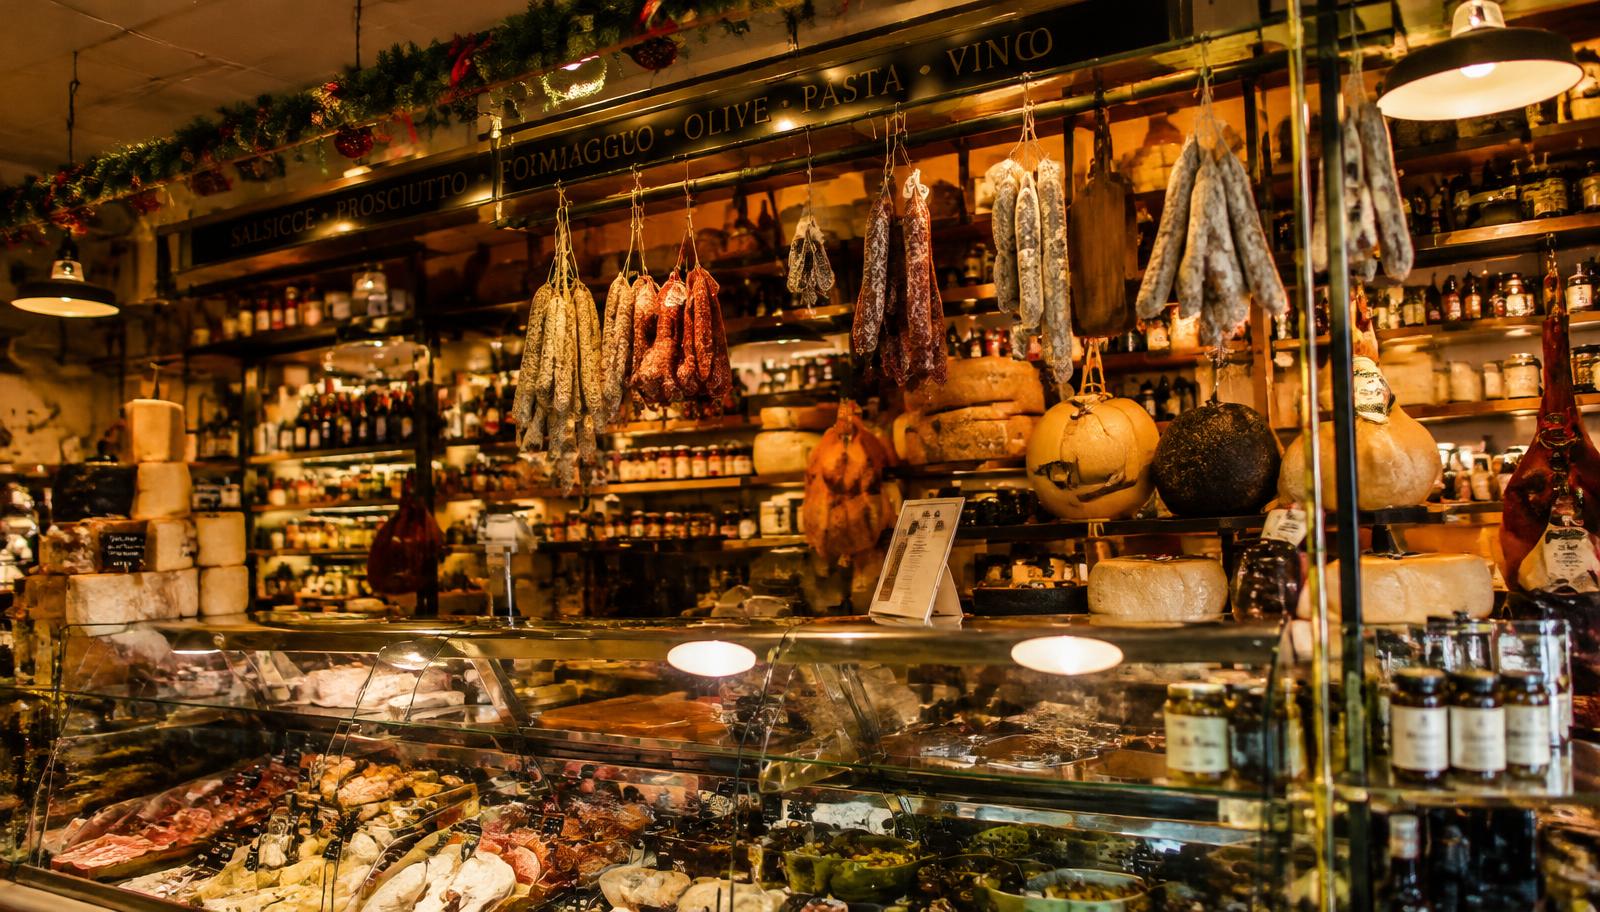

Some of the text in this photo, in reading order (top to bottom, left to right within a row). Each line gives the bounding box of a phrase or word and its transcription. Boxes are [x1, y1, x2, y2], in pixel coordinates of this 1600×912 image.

[684, 96, 771, 140] OLIVE
[802, 64, 904, 114] PASTA
[231, 171, 468, 248] SALSICCE PROSCIUTTO
